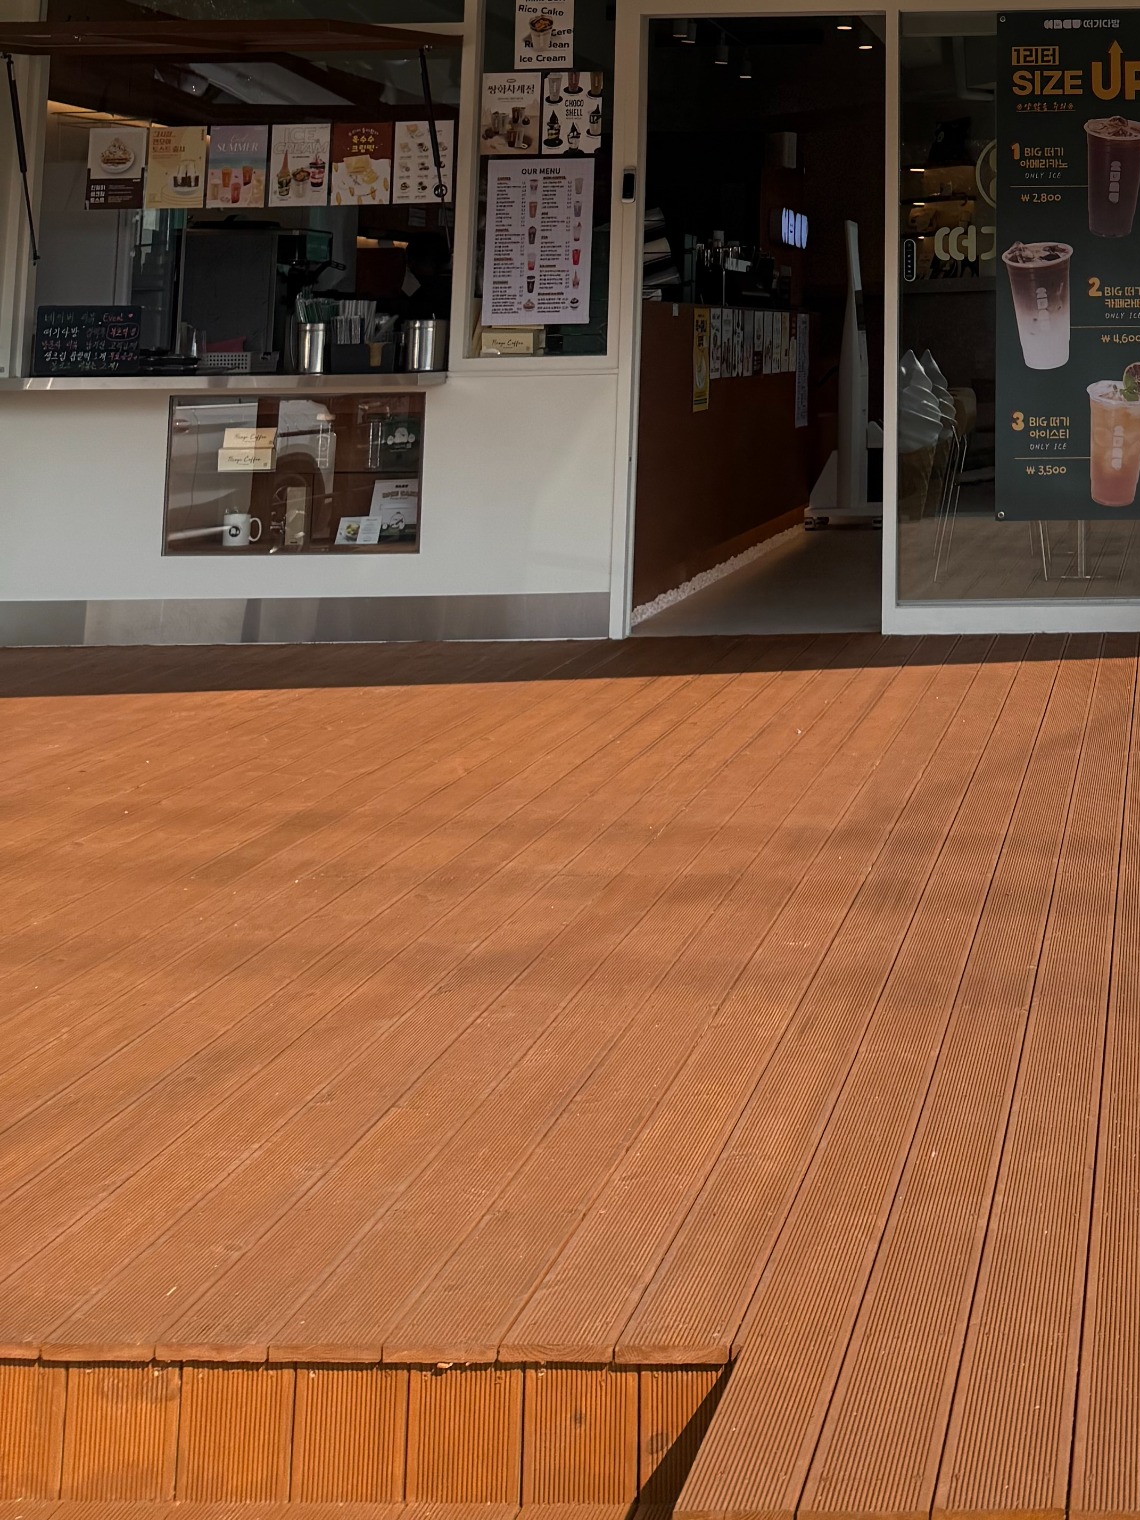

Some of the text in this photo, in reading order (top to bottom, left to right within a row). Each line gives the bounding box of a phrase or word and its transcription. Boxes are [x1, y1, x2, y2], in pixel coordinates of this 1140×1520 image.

[518, 5, 564, 16] Rice Cake
[1083, 19, 1120, 28] 떠기다방
[551, 28, 573, 37] Cere
[536, 54, 566, 62] Cream
[1013, 47, 1058, 65] 1리터
[1012, 70, 1083, 96] SIZE
[565, 99, 584, 107] CHOCO
[566, 109, 583, 117] SHELL
[284, 127, 316, 143] ICE
[217, 142, 258, 152] SUMMER
[1012, 142, 1020, 160] 1
[1024, 147, 1064, 157] BIG 떠기
[1020, 159, 1068, 169] 아메리카노
[539, 167, 561, 175] MENU
[1088, 277, 1102, 296] 2
[1104, 286, 1122, 296] BIG
[1012, 411, 1024, 430] 3
[1029, 416, 1070, 427] BIG 떠기
[1029, 429, 1069, 439] 아이스티
[1054, 442, 1067, 450] ICE
